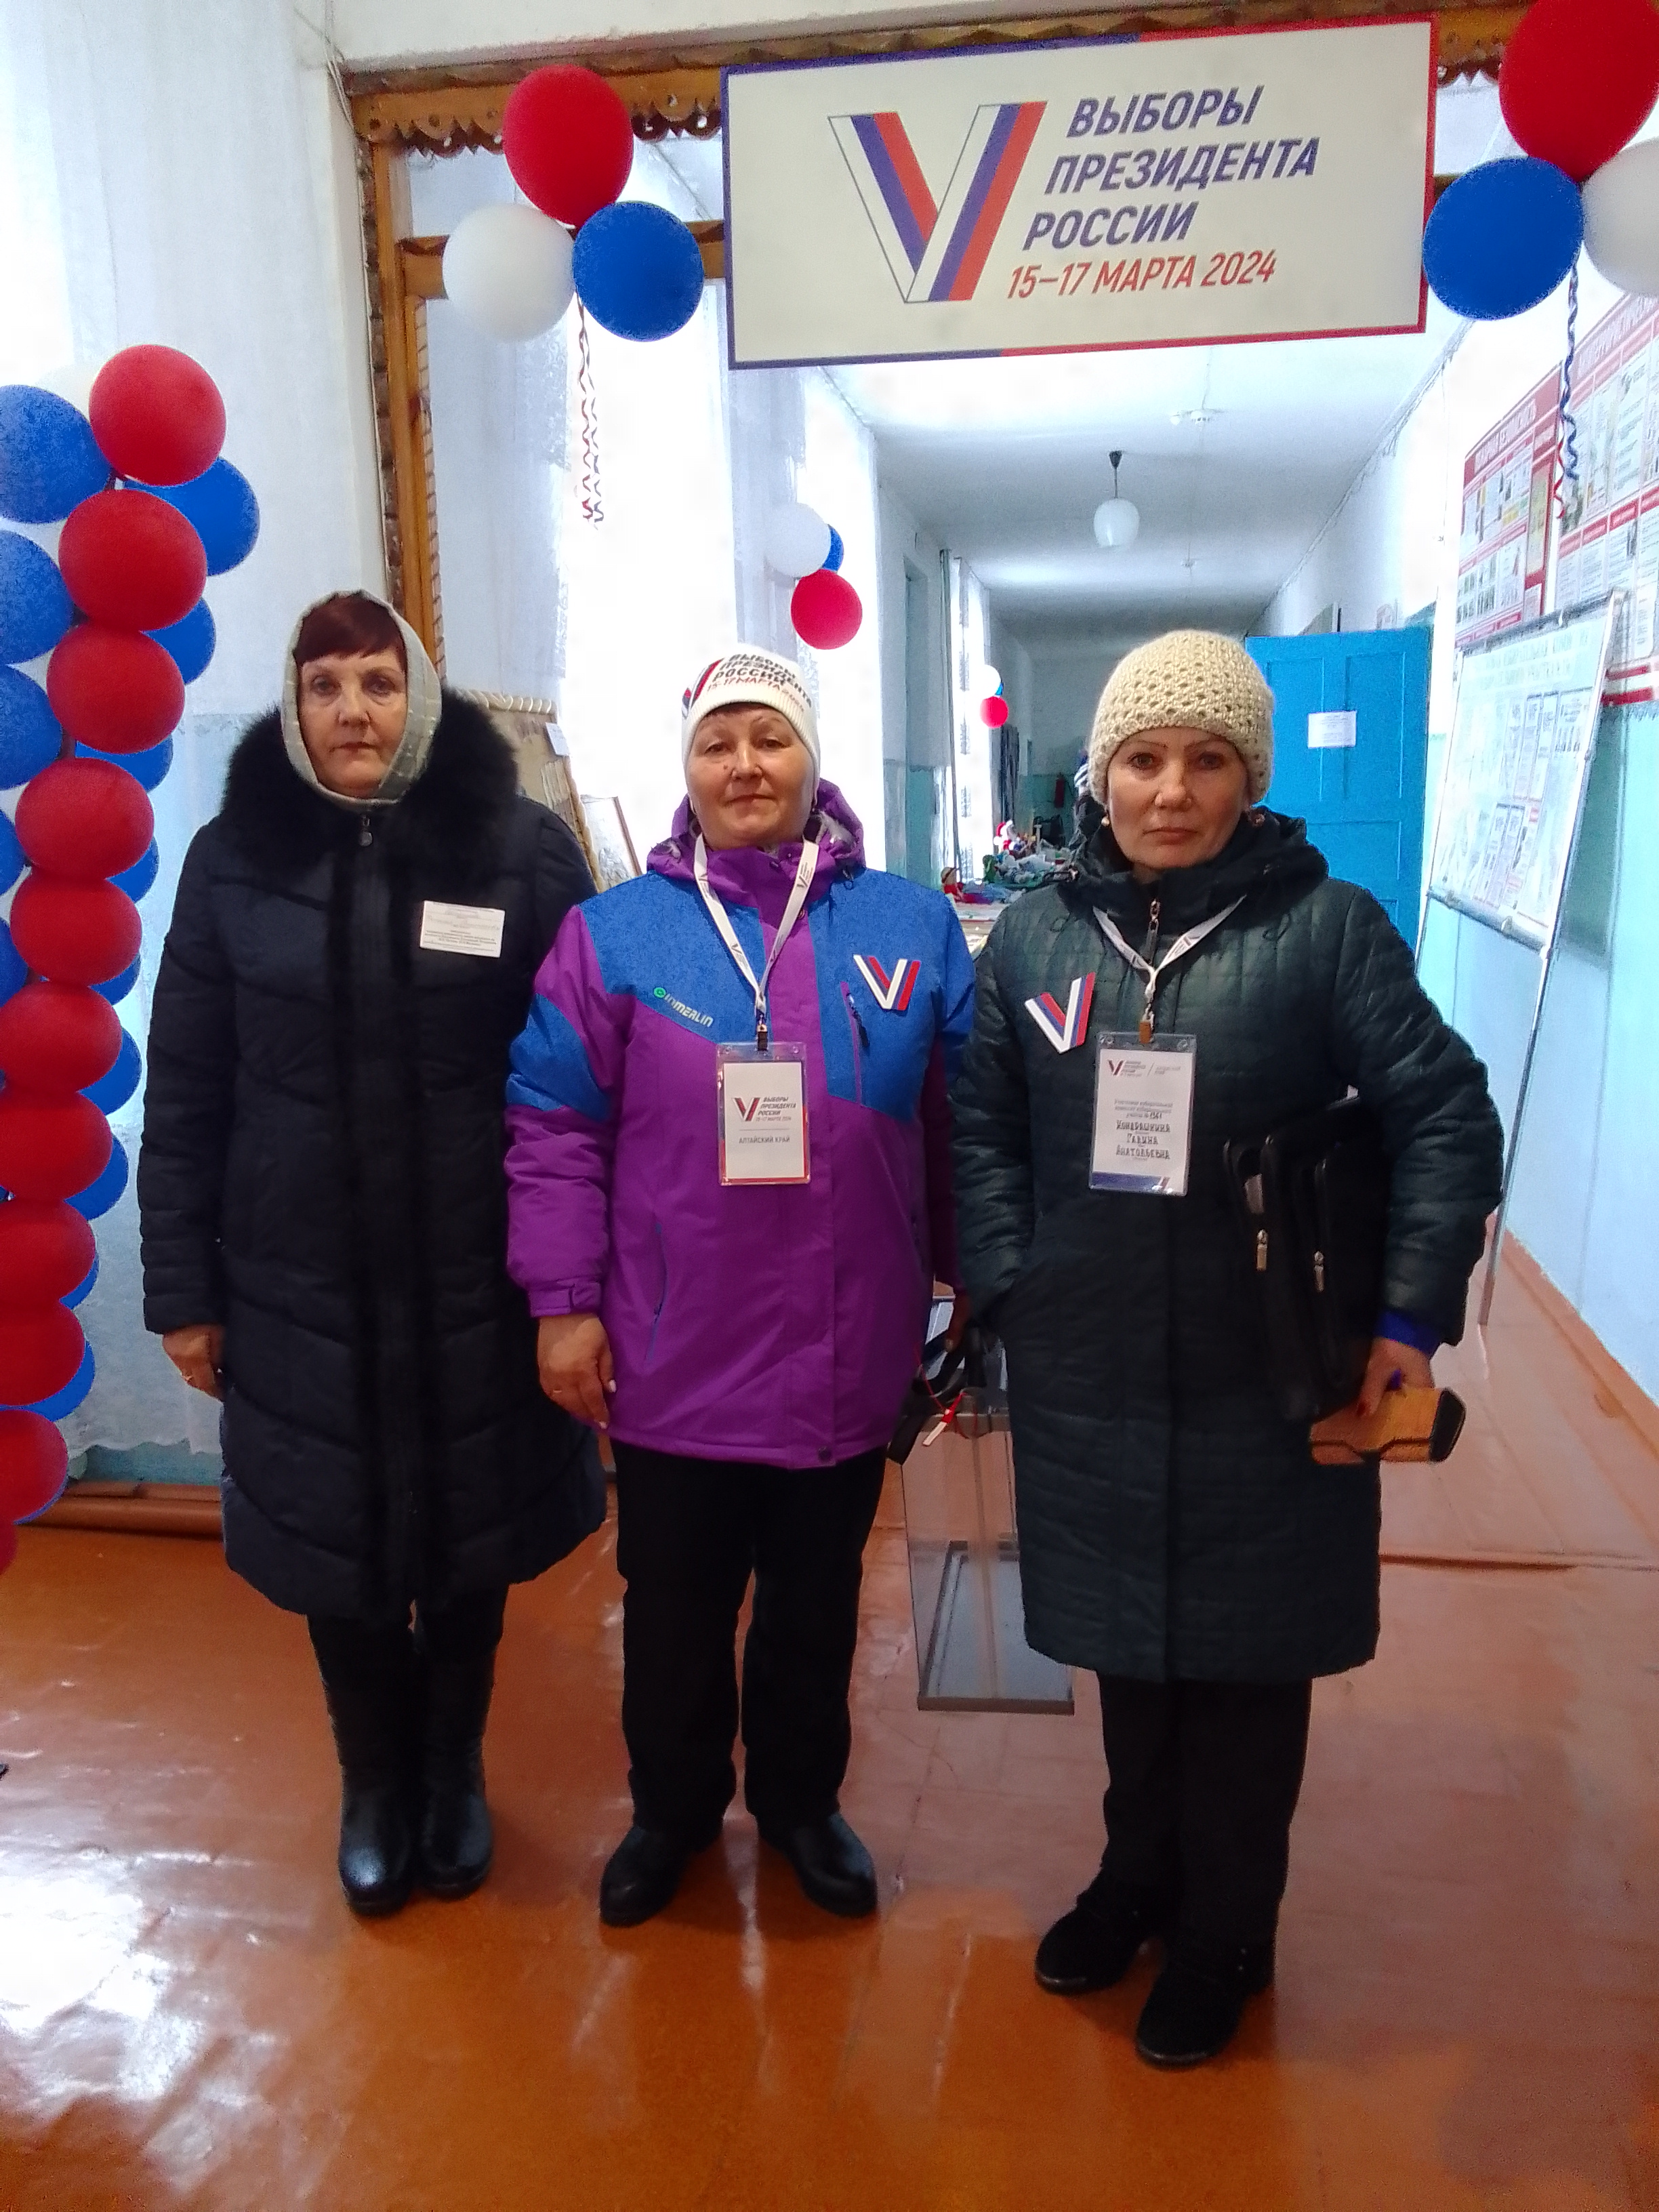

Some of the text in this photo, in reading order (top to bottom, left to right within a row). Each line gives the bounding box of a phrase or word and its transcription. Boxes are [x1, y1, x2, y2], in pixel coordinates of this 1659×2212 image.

[1066, 85, 1264, 138] ВЫБОРЫ
[1044, 138, 1320, 195] ПРЕЗИДЕНТА
[1023, 201, 1198, 251] РОССИИ
[1092, 253, 1195, 294] МАРТА
[1201, 249, 1277, 287] 2024
[712, 667, 786, 686] РОССИИ
[729, 653, 796, 679] ВЫБОРЫ
[739, 1134, 790, 1144] АЛТАЙСКИЙ КРАЙ
